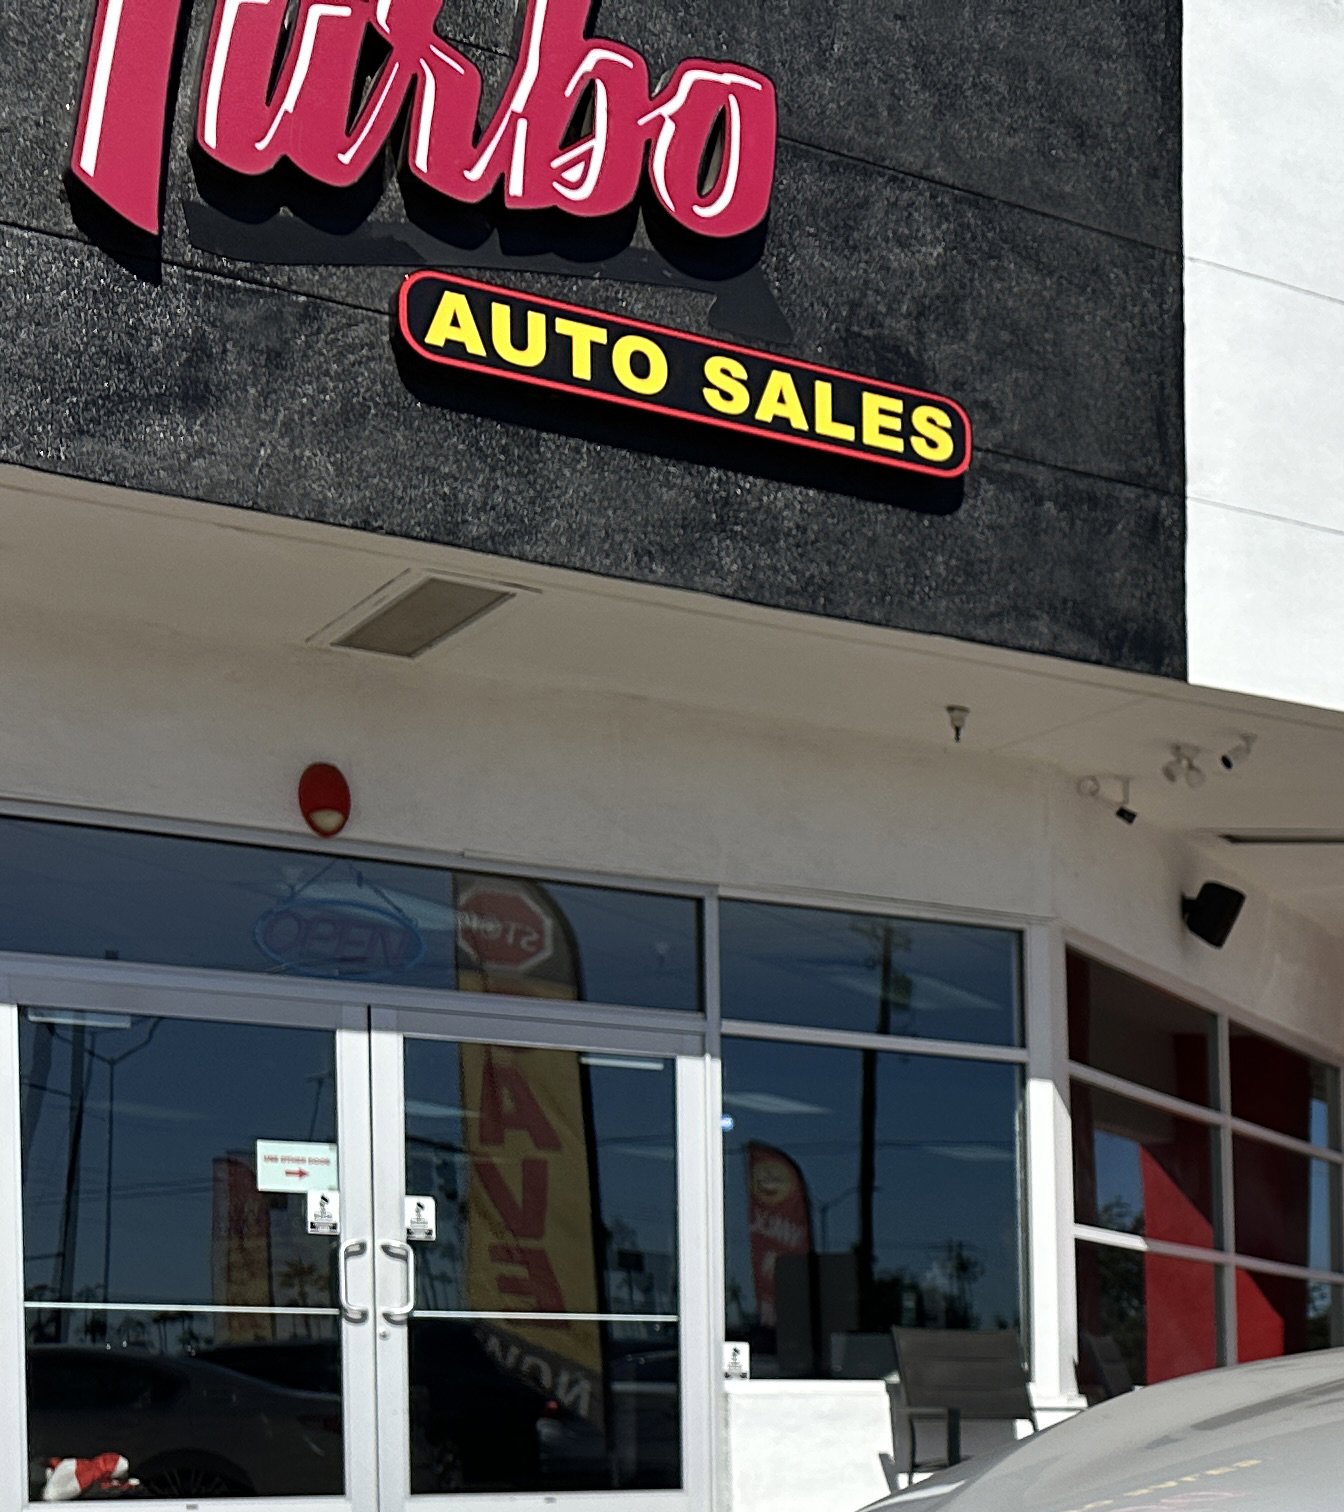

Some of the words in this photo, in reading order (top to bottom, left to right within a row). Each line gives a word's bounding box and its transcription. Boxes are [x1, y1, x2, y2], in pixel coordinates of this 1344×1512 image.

[425, 290, 669, 395] AUTO
[703, 355, 955, 461] SALES
[264, 912, 412, 967] OPEN
